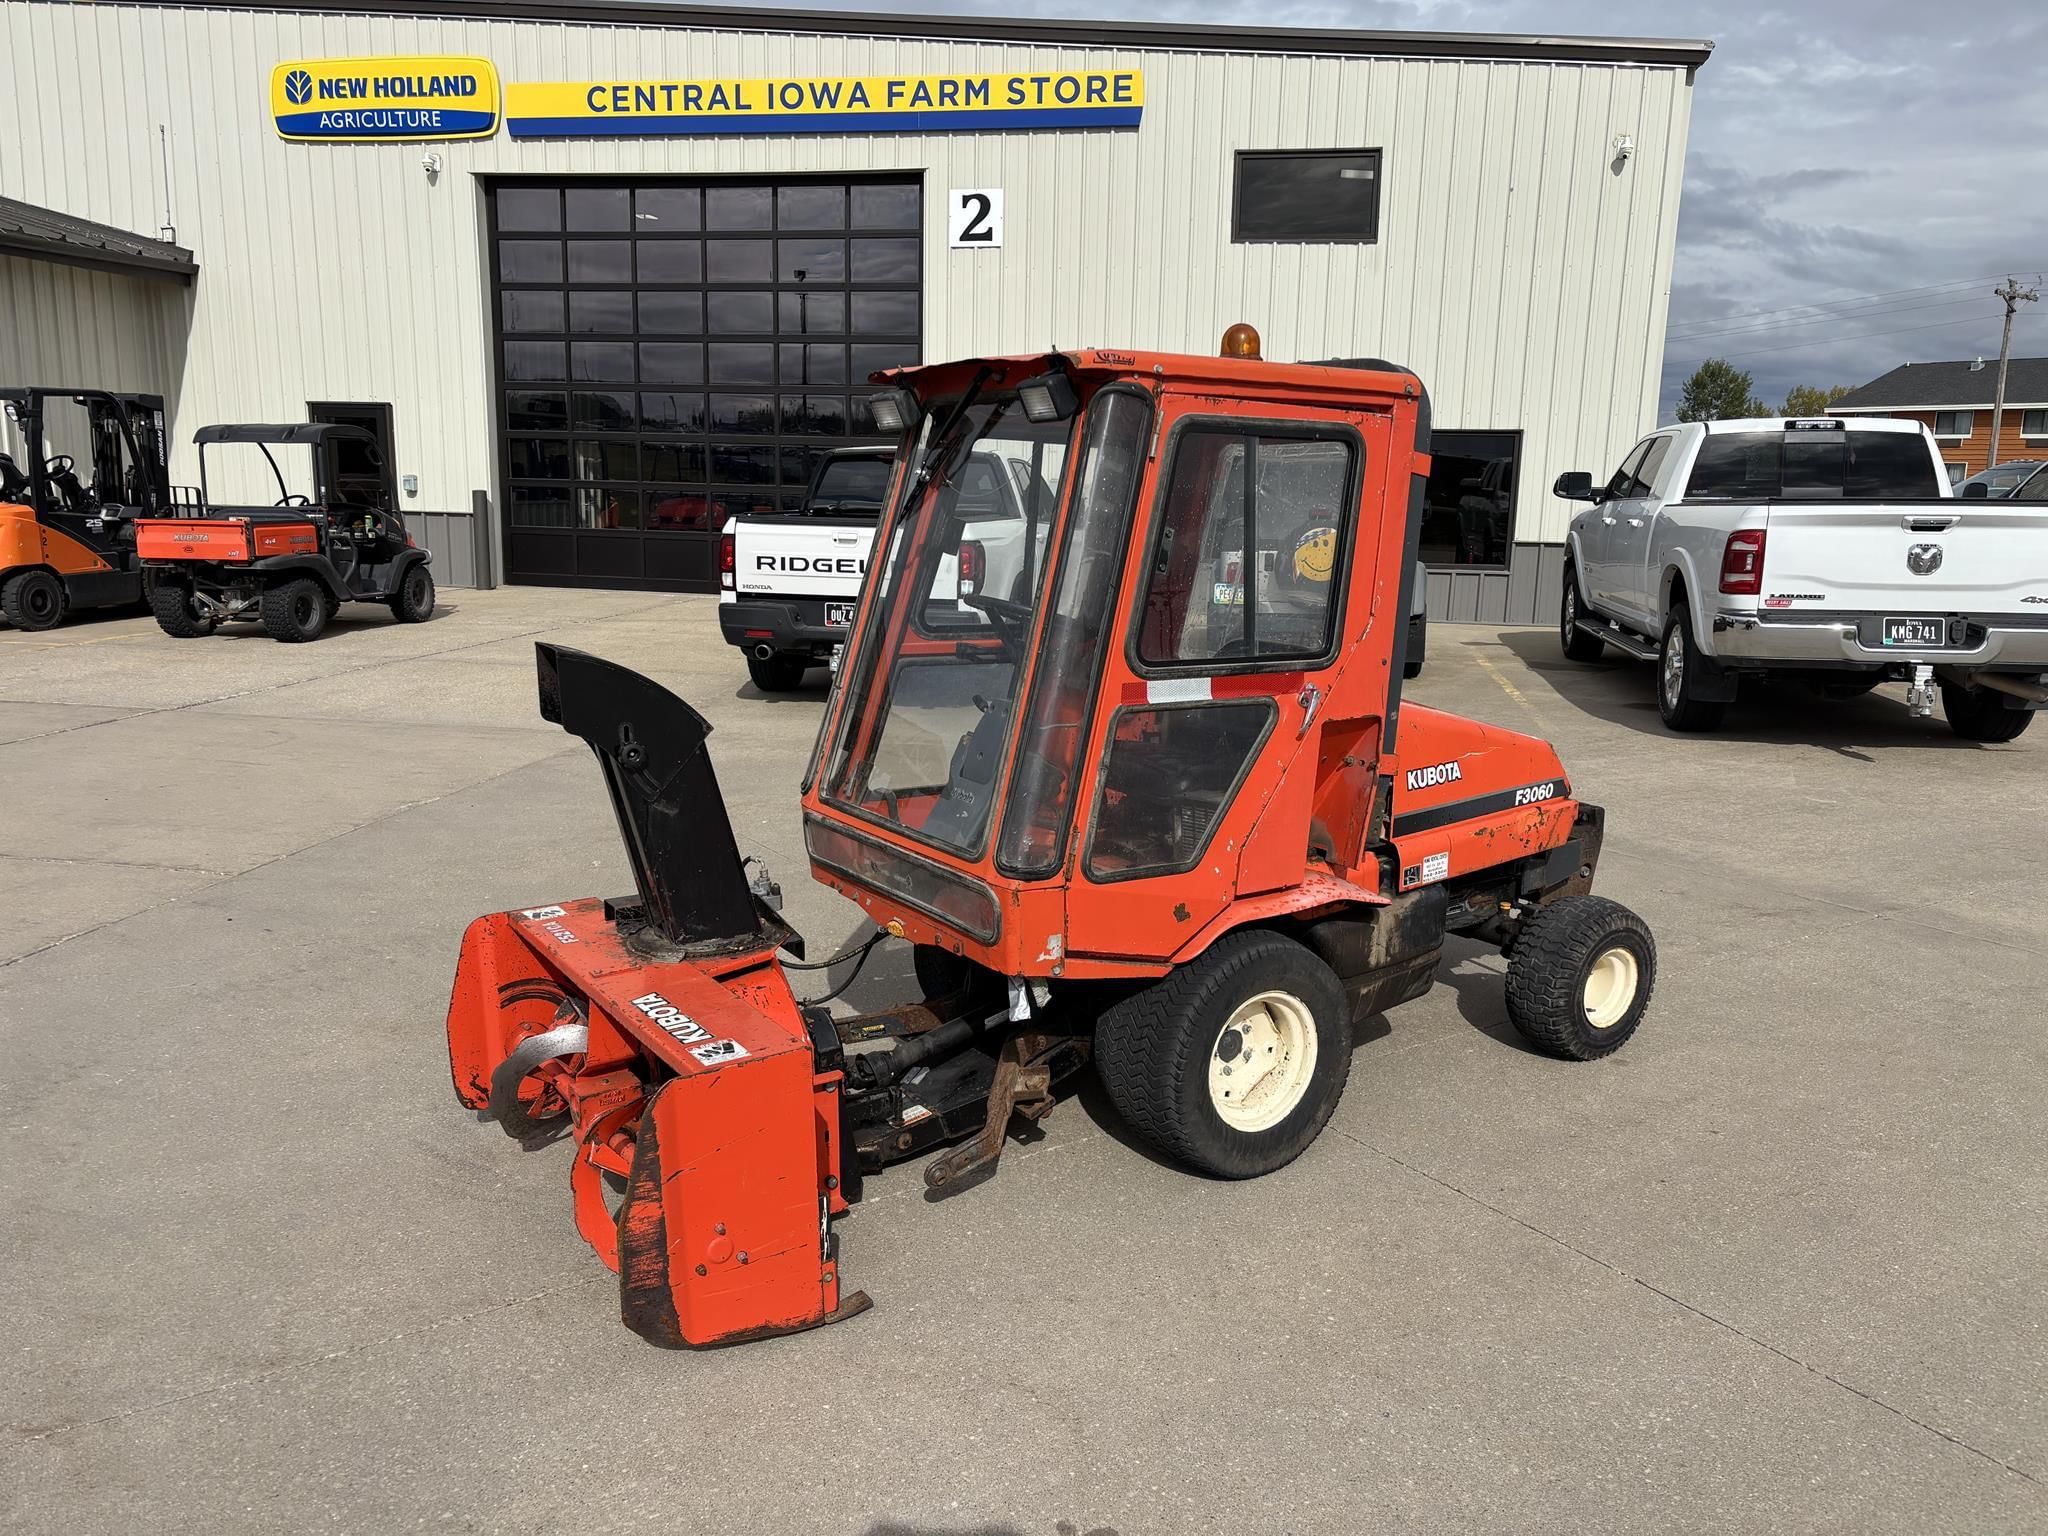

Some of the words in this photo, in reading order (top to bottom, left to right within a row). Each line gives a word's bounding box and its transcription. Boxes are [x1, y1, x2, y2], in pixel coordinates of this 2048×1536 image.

[318, 77, 367, 98] NEW
[373, 75, 476, 98] HOLLAND
[587, 83, 752, 112] CENTRAL
[768, 81, 870, 110] IOWA
[887, 79, 990, 107] FARM
[1006, 74, 1133, 104] STORE
[320, 110, 442, 128] AGRICULTURE
[959, 193, 993, 241] 2
[85, 518, 103, 527] 25
[174, 534, 209, 542] KUBOTA
[742, 583, 773, 591] HONDA
[1916, 625, 1936, 640] 741
[1407, 761, 1462, 791] KUBOTA
[1515, 783, 1554, 806] F3060
[631, 991, 715, 1045] KUBOTA
